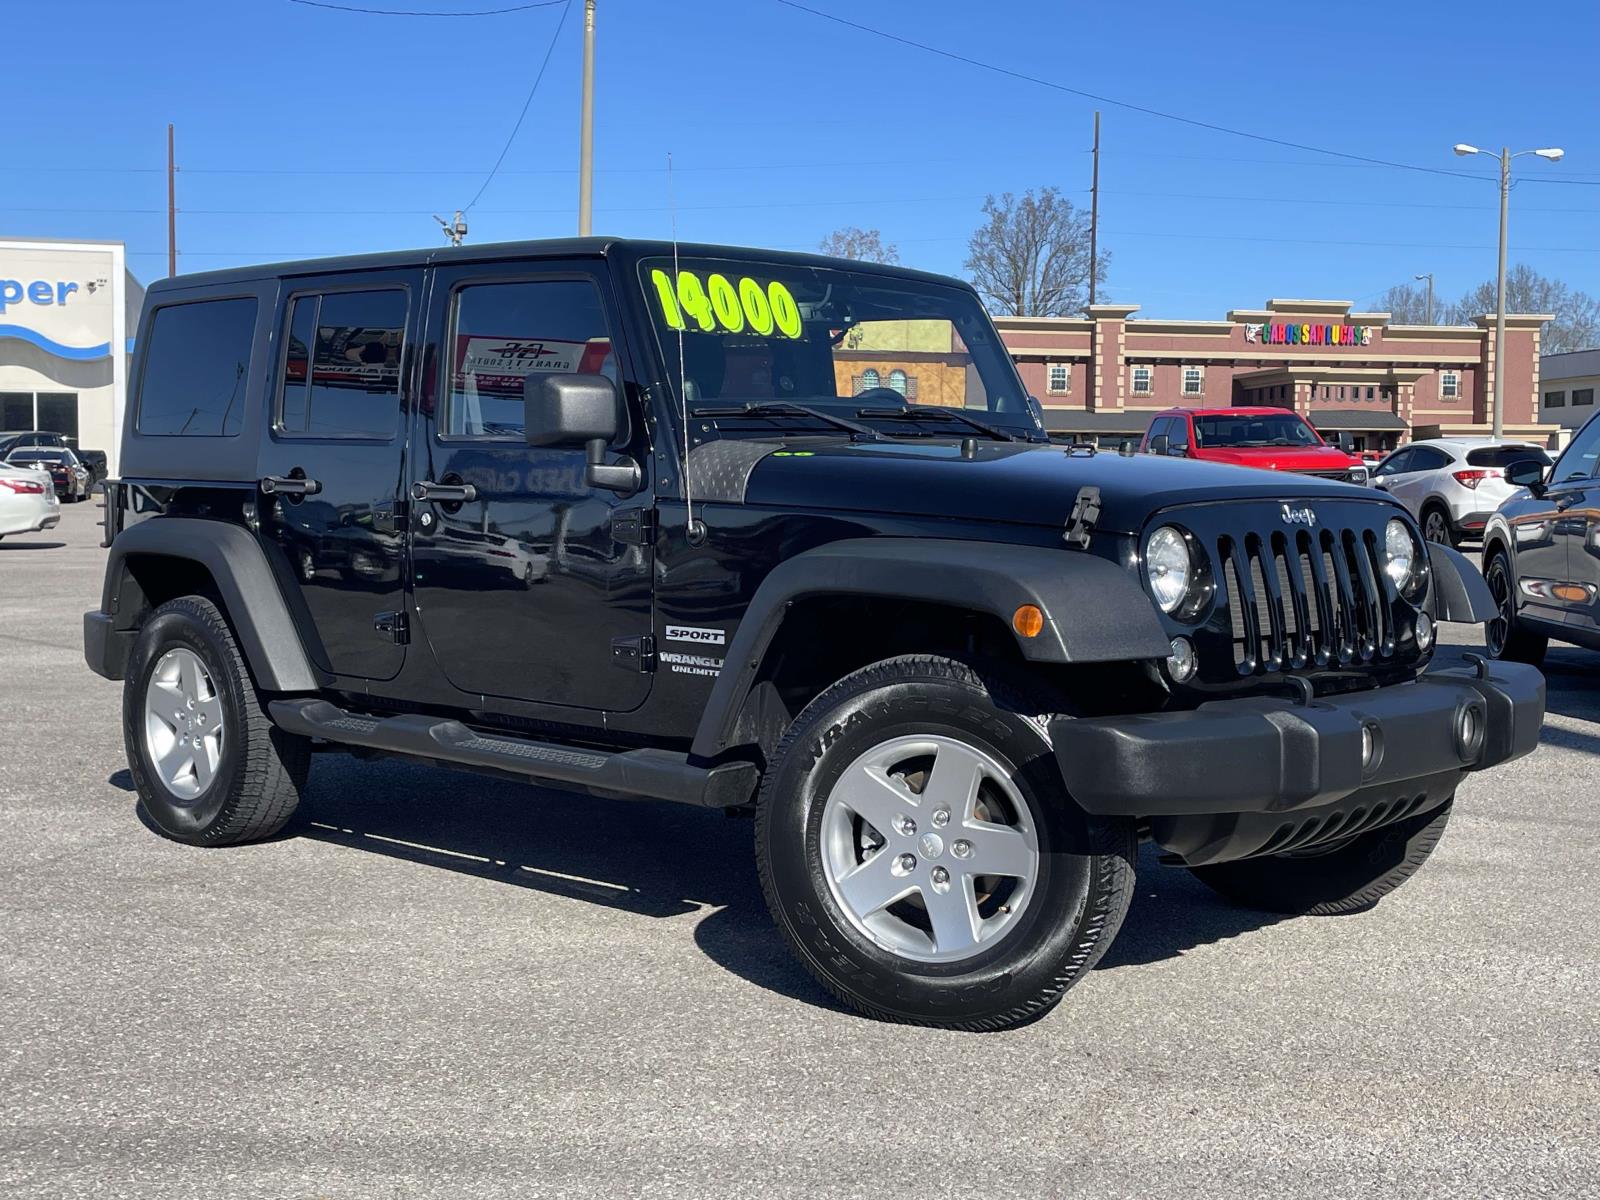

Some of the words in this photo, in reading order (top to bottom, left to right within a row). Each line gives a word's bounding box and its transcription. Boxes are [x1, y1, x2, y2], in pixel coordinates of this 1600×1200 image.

[0, 280, 79, 315] per
[652, 269, 802, 339] 14000
[1262, 323, 1300, 345] CABOS
[1301, 323, 1324, 345] SAN
[1325, 324, 1361, 346] LUCAS
[1282, 504, 1316, 527] Jeep
[667, 629, 724, 641] SPORT
[660, 652, 724, 668] WRANGL
[671, 665, 720, 677] UNLIMITE
